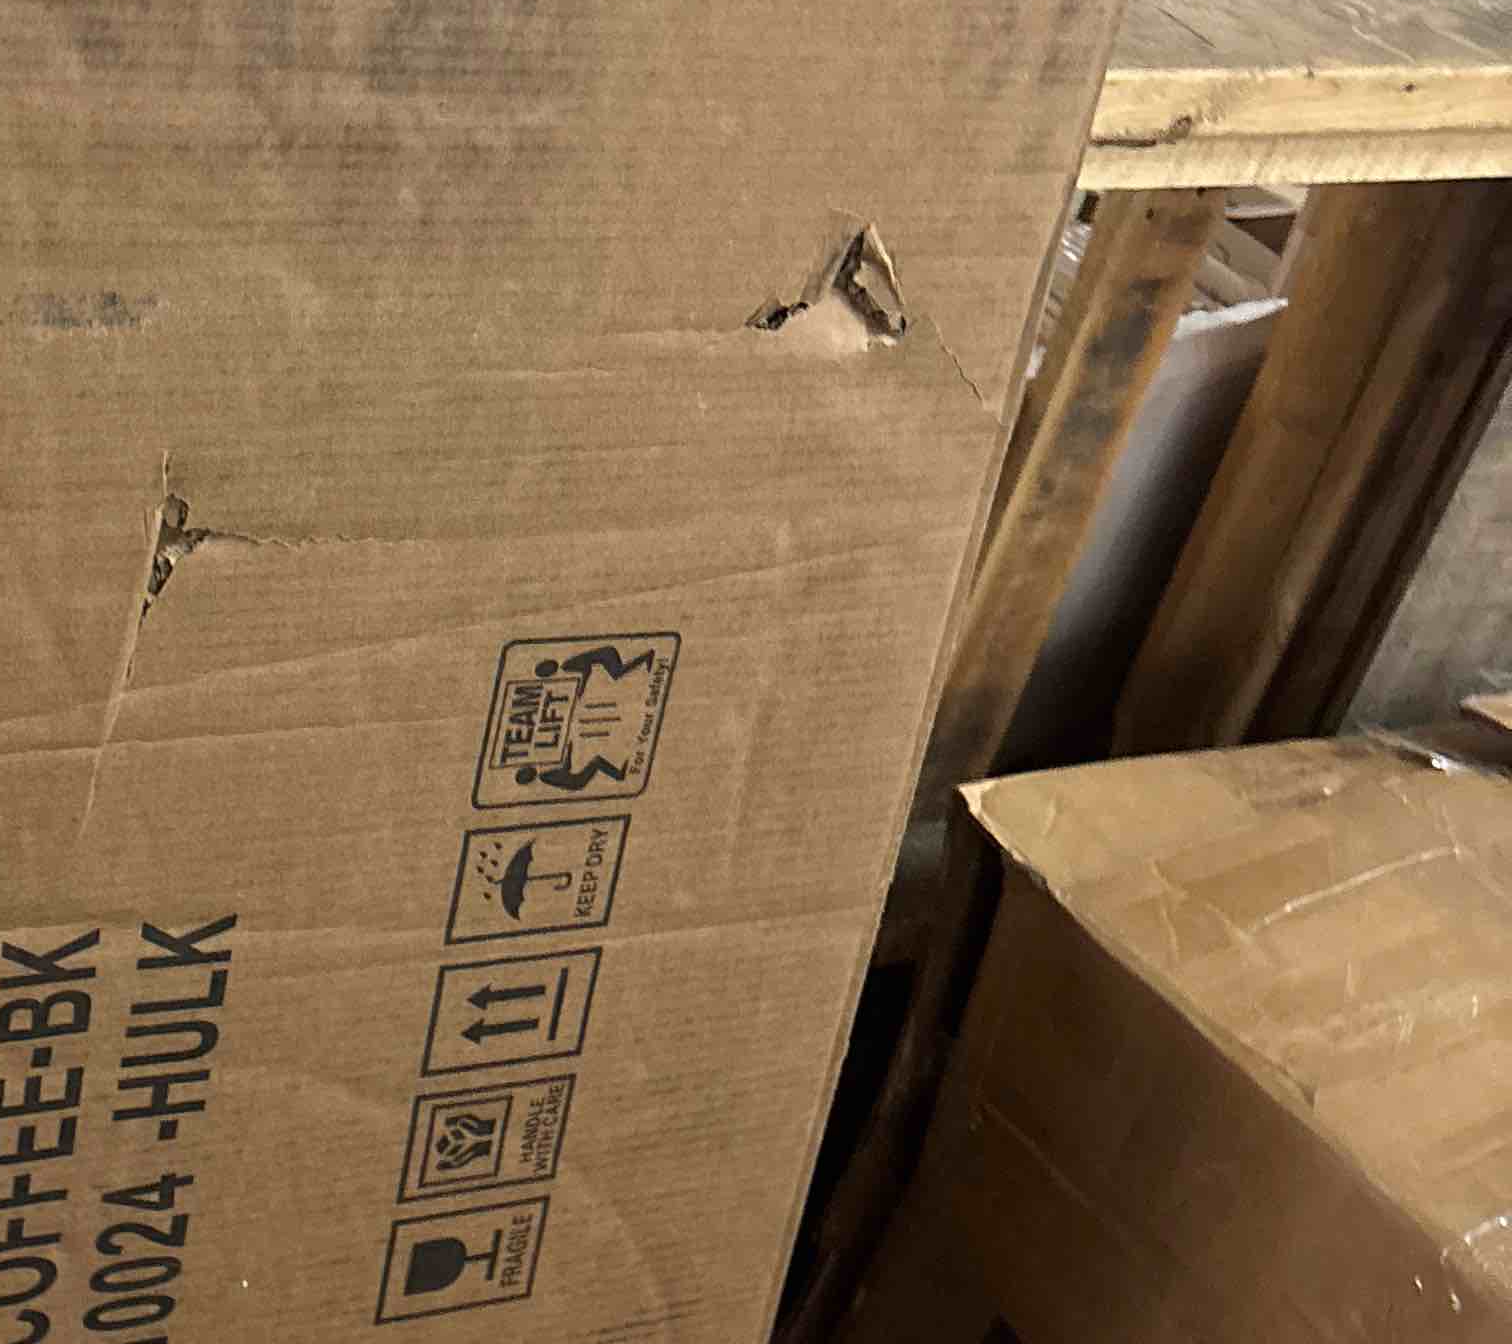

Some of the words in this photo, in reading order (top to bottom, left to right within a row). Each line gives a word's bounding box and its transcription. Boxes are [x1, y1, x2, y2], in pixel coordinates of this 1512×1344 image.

[499, 686, 542, 763] TEAM
[535, 691, 568, 750] LIFT
[636, 712, 653, 746] Your
[629, 751, 648, 776] For
[584, 827, 609, 868] DRY
[574, 870, 601, 918] KEEP
[541, 1082, 564, 1129] CARE
[517, 1096, 546, 1164] HANDLE
[533, 1131, 557, 1173] WITH
[499, 1213, 533, 1287] FRAGILE
